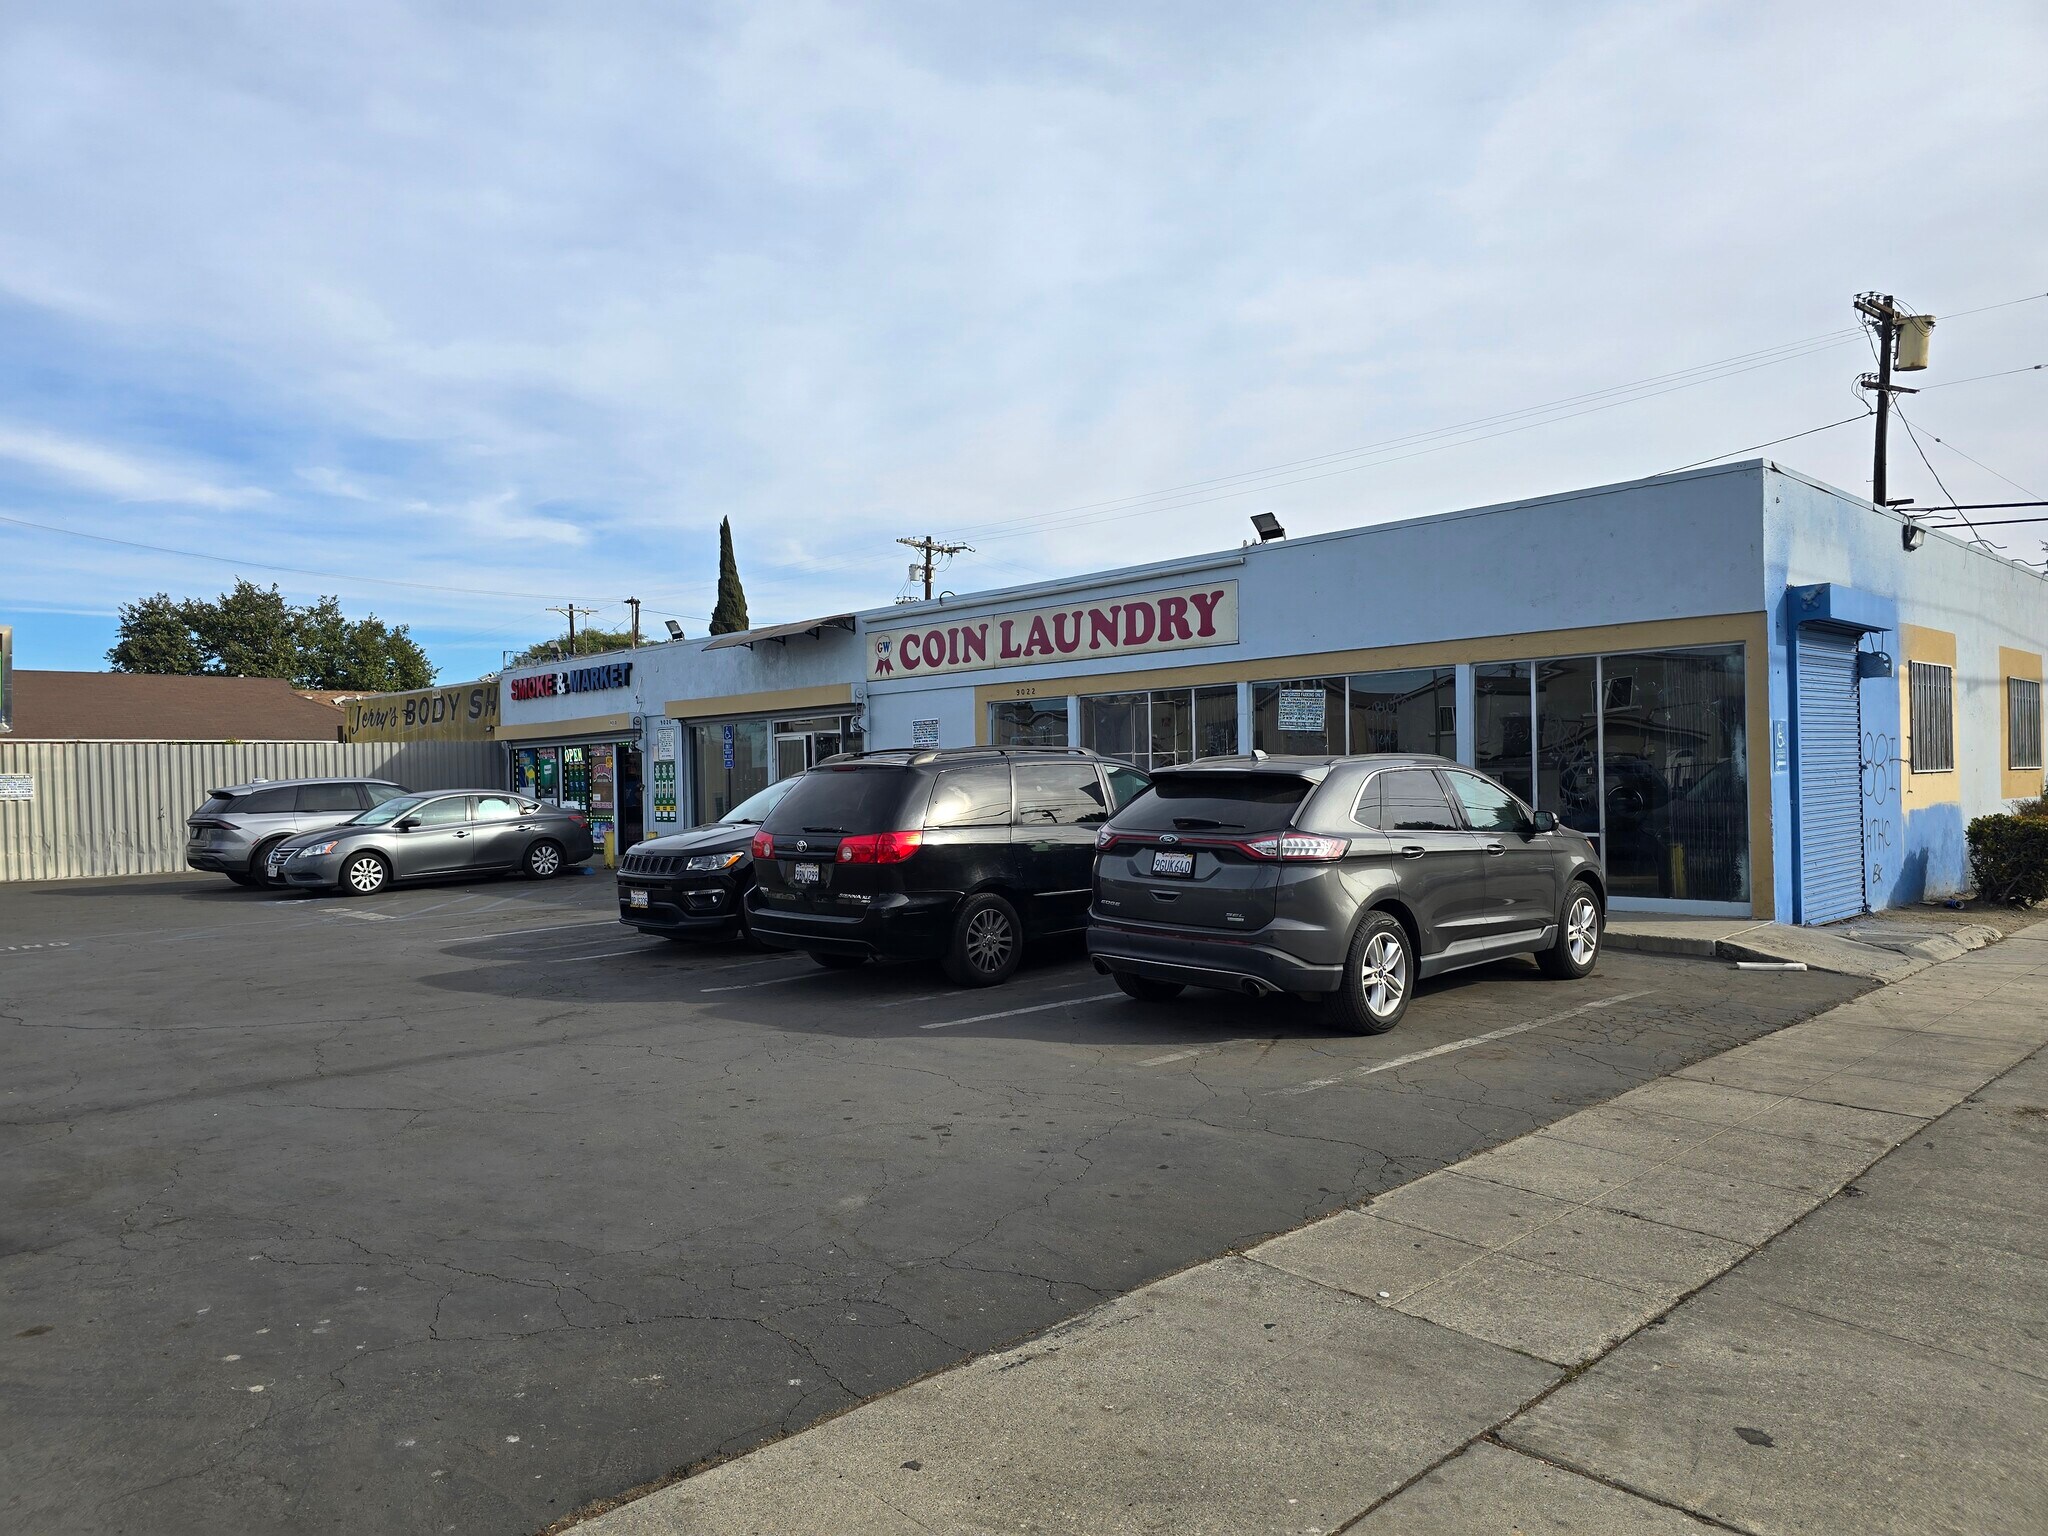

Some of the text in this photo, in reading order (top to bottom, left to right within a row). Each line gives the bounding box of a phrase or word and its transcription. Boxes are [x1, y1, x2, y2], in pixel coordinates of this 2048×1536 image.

[899, 590, 1225, 670] COIN LAUNDRY
[877, 640, 892, 653] GW
[511, 662, 633, 701] SMOKE & MARKET
[1016, 687, 1036, 696] 9022
[351, 705, 399, 735] Jerry's
[404, 693, 460, 726] BODY
[564, 748, 583, 762] OPEN
[1154, 859, 1190, 873] 9GUK640
[1101, 899, 1121, 907] EDGE
